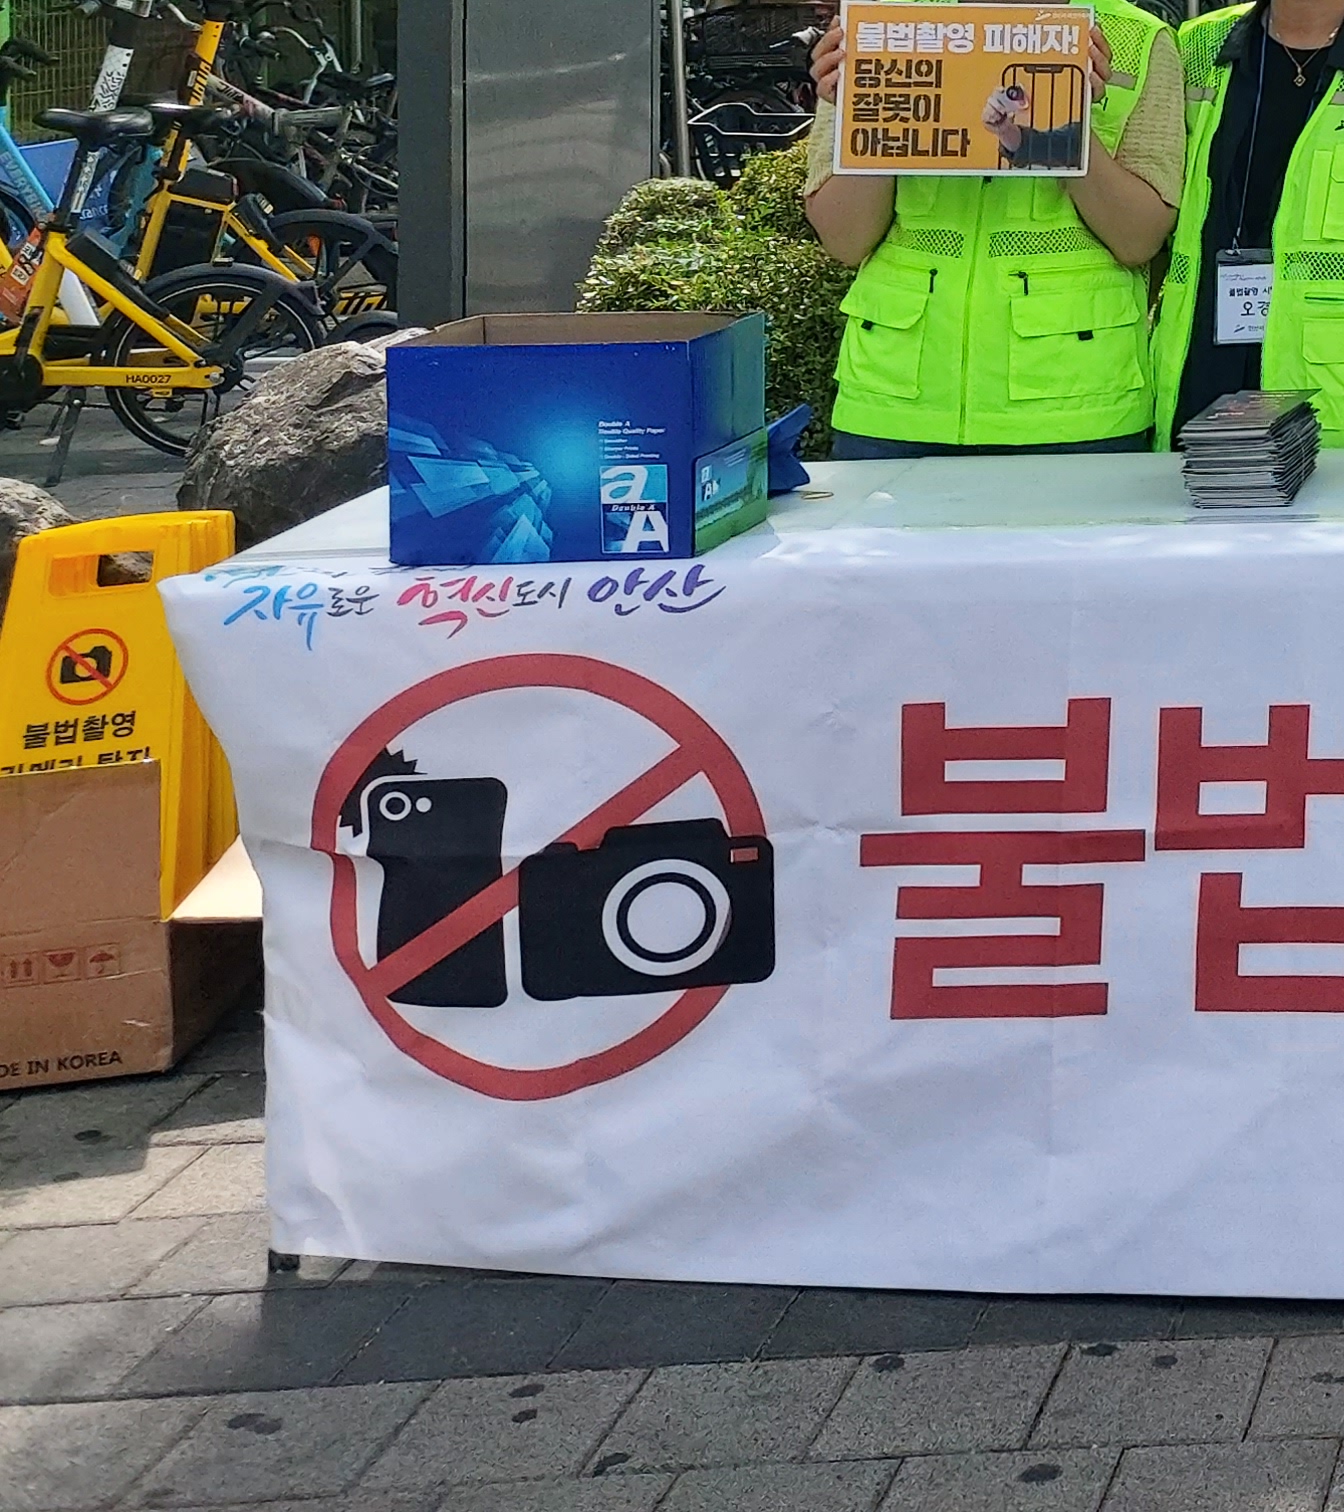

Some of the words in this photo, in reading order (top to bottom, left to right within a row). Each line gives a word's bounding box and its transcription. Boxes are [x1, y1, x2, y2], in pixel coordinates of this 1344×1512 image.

[856, 21, 975, 54] 불법촬영
[983, 24, 1081, 55] 피해자!
[854, 58, 943, 89] 당신의
[852, 93, 942, 123] 잘못이
[850, 128, 971, 158] 아닙니다
[125, 374, 172, 384] HA0027
[611, 504, 645, 512] Double
[621, 511, 670, 553] A
[223, 583, 381, 651] 자유로운
[396, 575, 573, 640] 혁신도시
[587, 563, 727, 617] 안산
[23, 710, 137, 750] 불법촬영
[27, 1059, 49, 1075] IN
[57, 1050, 123, 1071] KOREA
